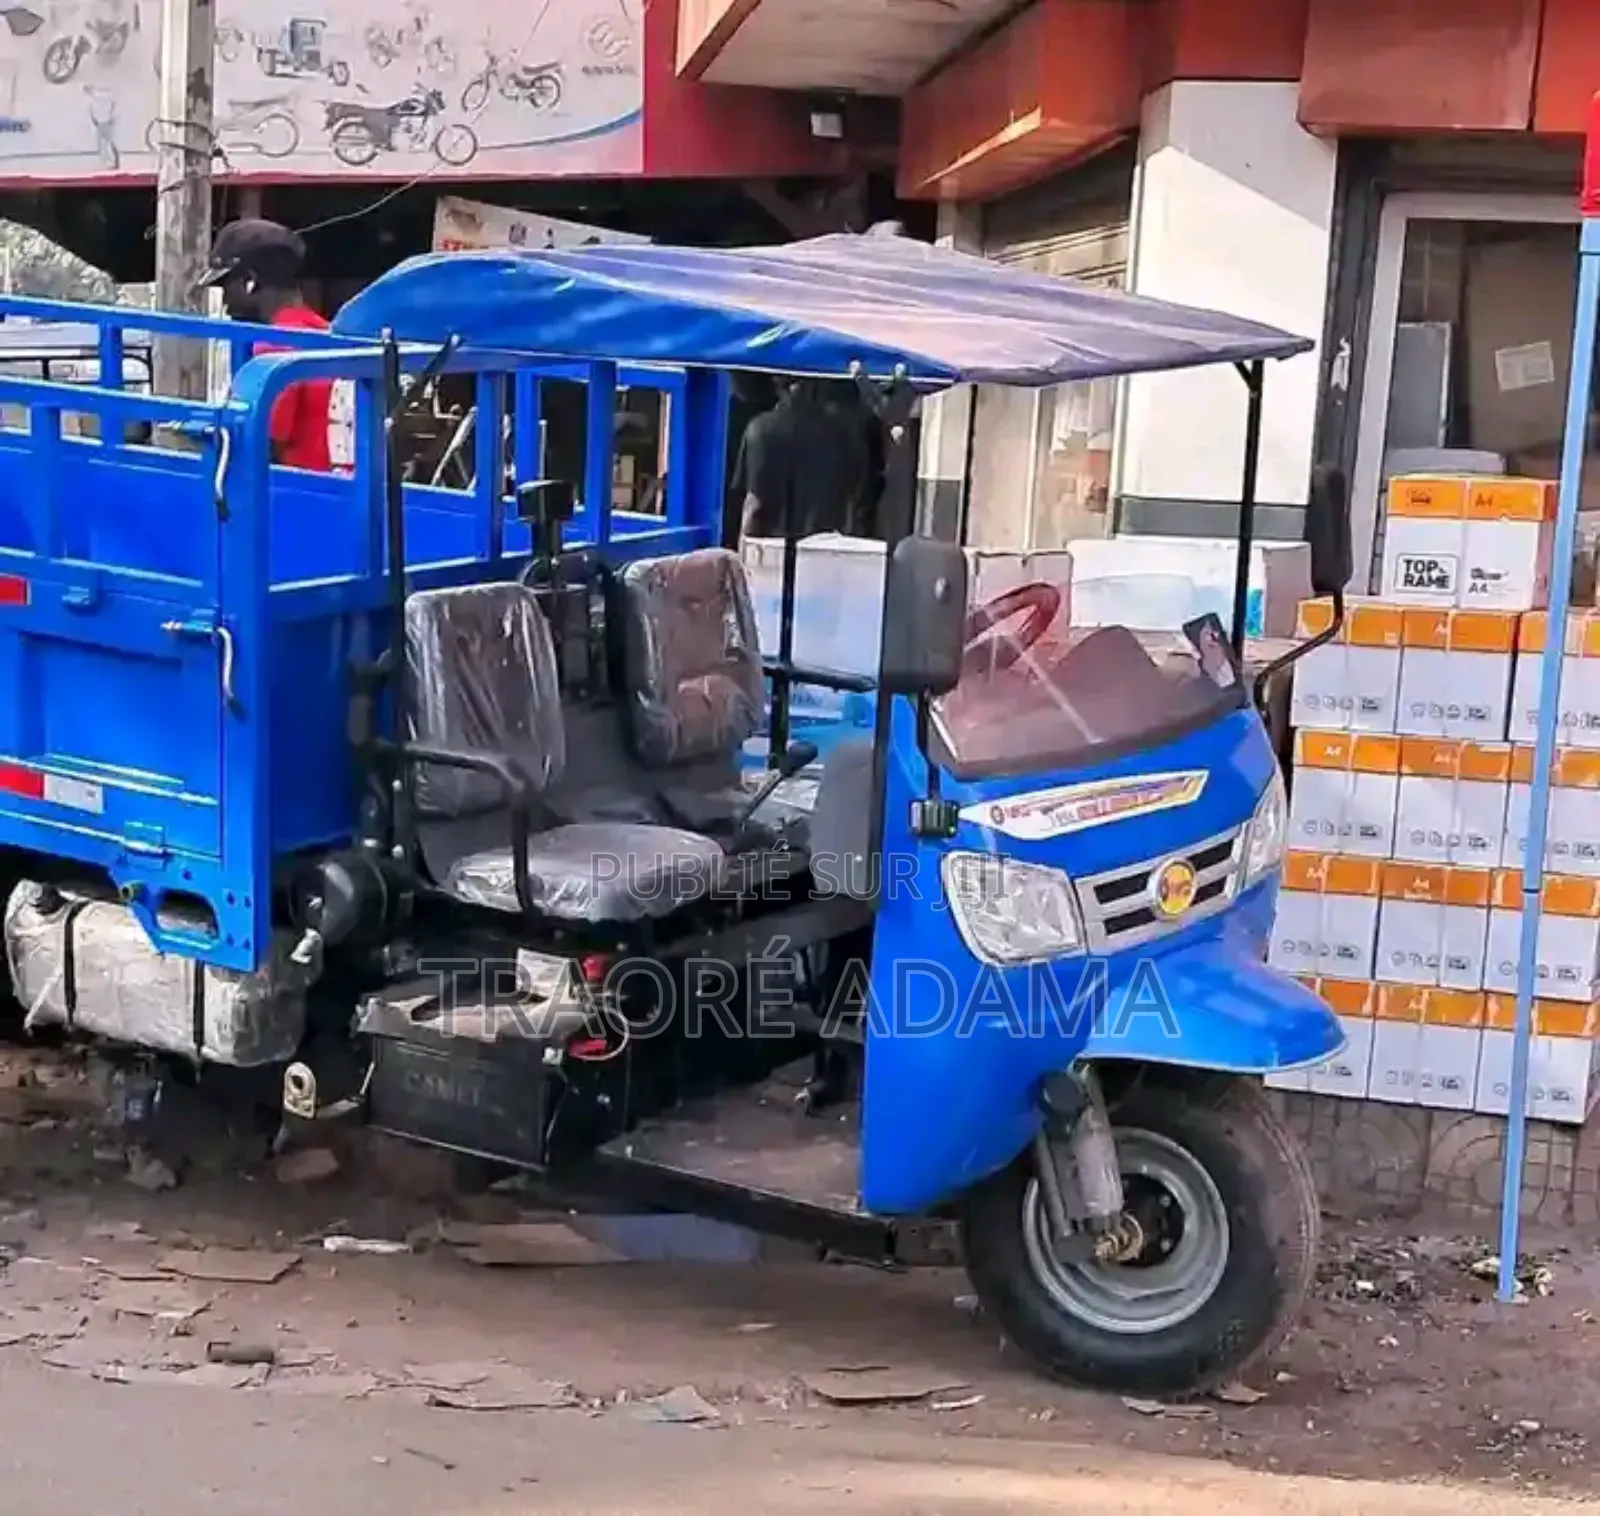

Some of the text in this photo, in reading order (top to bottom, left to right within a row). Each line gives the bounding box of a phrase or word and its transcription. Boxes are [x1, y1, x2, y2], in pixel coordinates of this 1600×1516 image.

[1475, 494, 1493, 507] A4
[1403, 559, 1439, 574] TOP
[1403, 574, 1450, 589] RAME
[1468, 582, 1489, 595] A4
